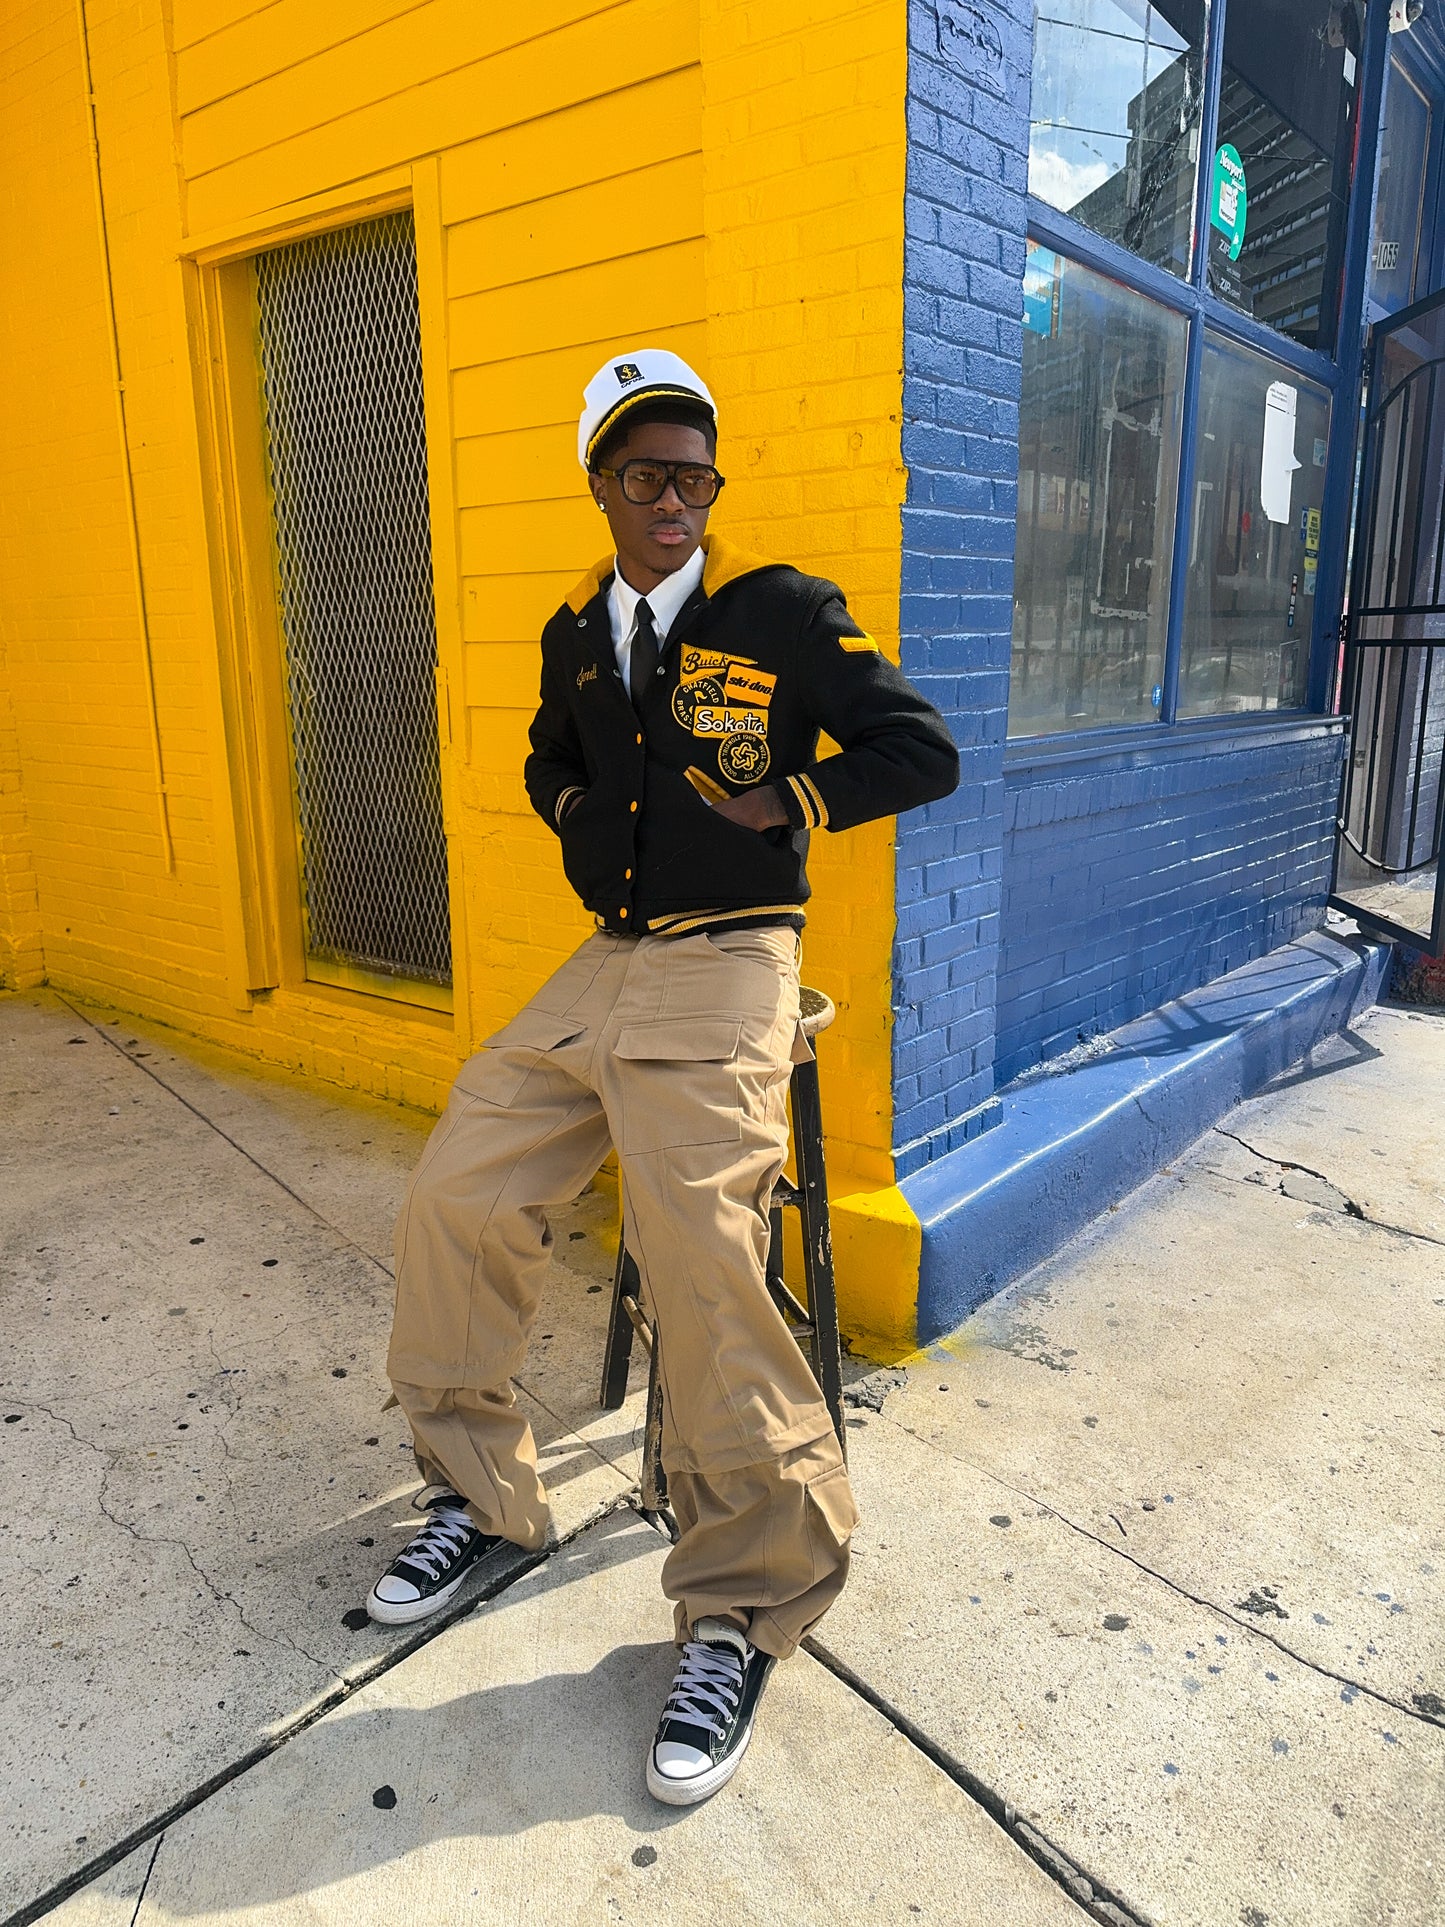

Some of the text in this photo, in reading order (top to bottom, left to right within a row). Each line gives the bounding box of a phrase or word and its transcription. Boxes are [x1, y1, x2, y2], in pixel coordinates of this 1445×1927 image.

[1220, 149, 1243, 180] Newport
[1377, 243, 1399, 268] 1055
[682, 651, 728, 675] Buick
[682, 680, 719, 703] CHATFIELD
[695, 709, 766, 734] Sokota
[721, 735, 741, 757] TRIANGLE
[744, 744, 767, 780] ALL STAR TEAM
